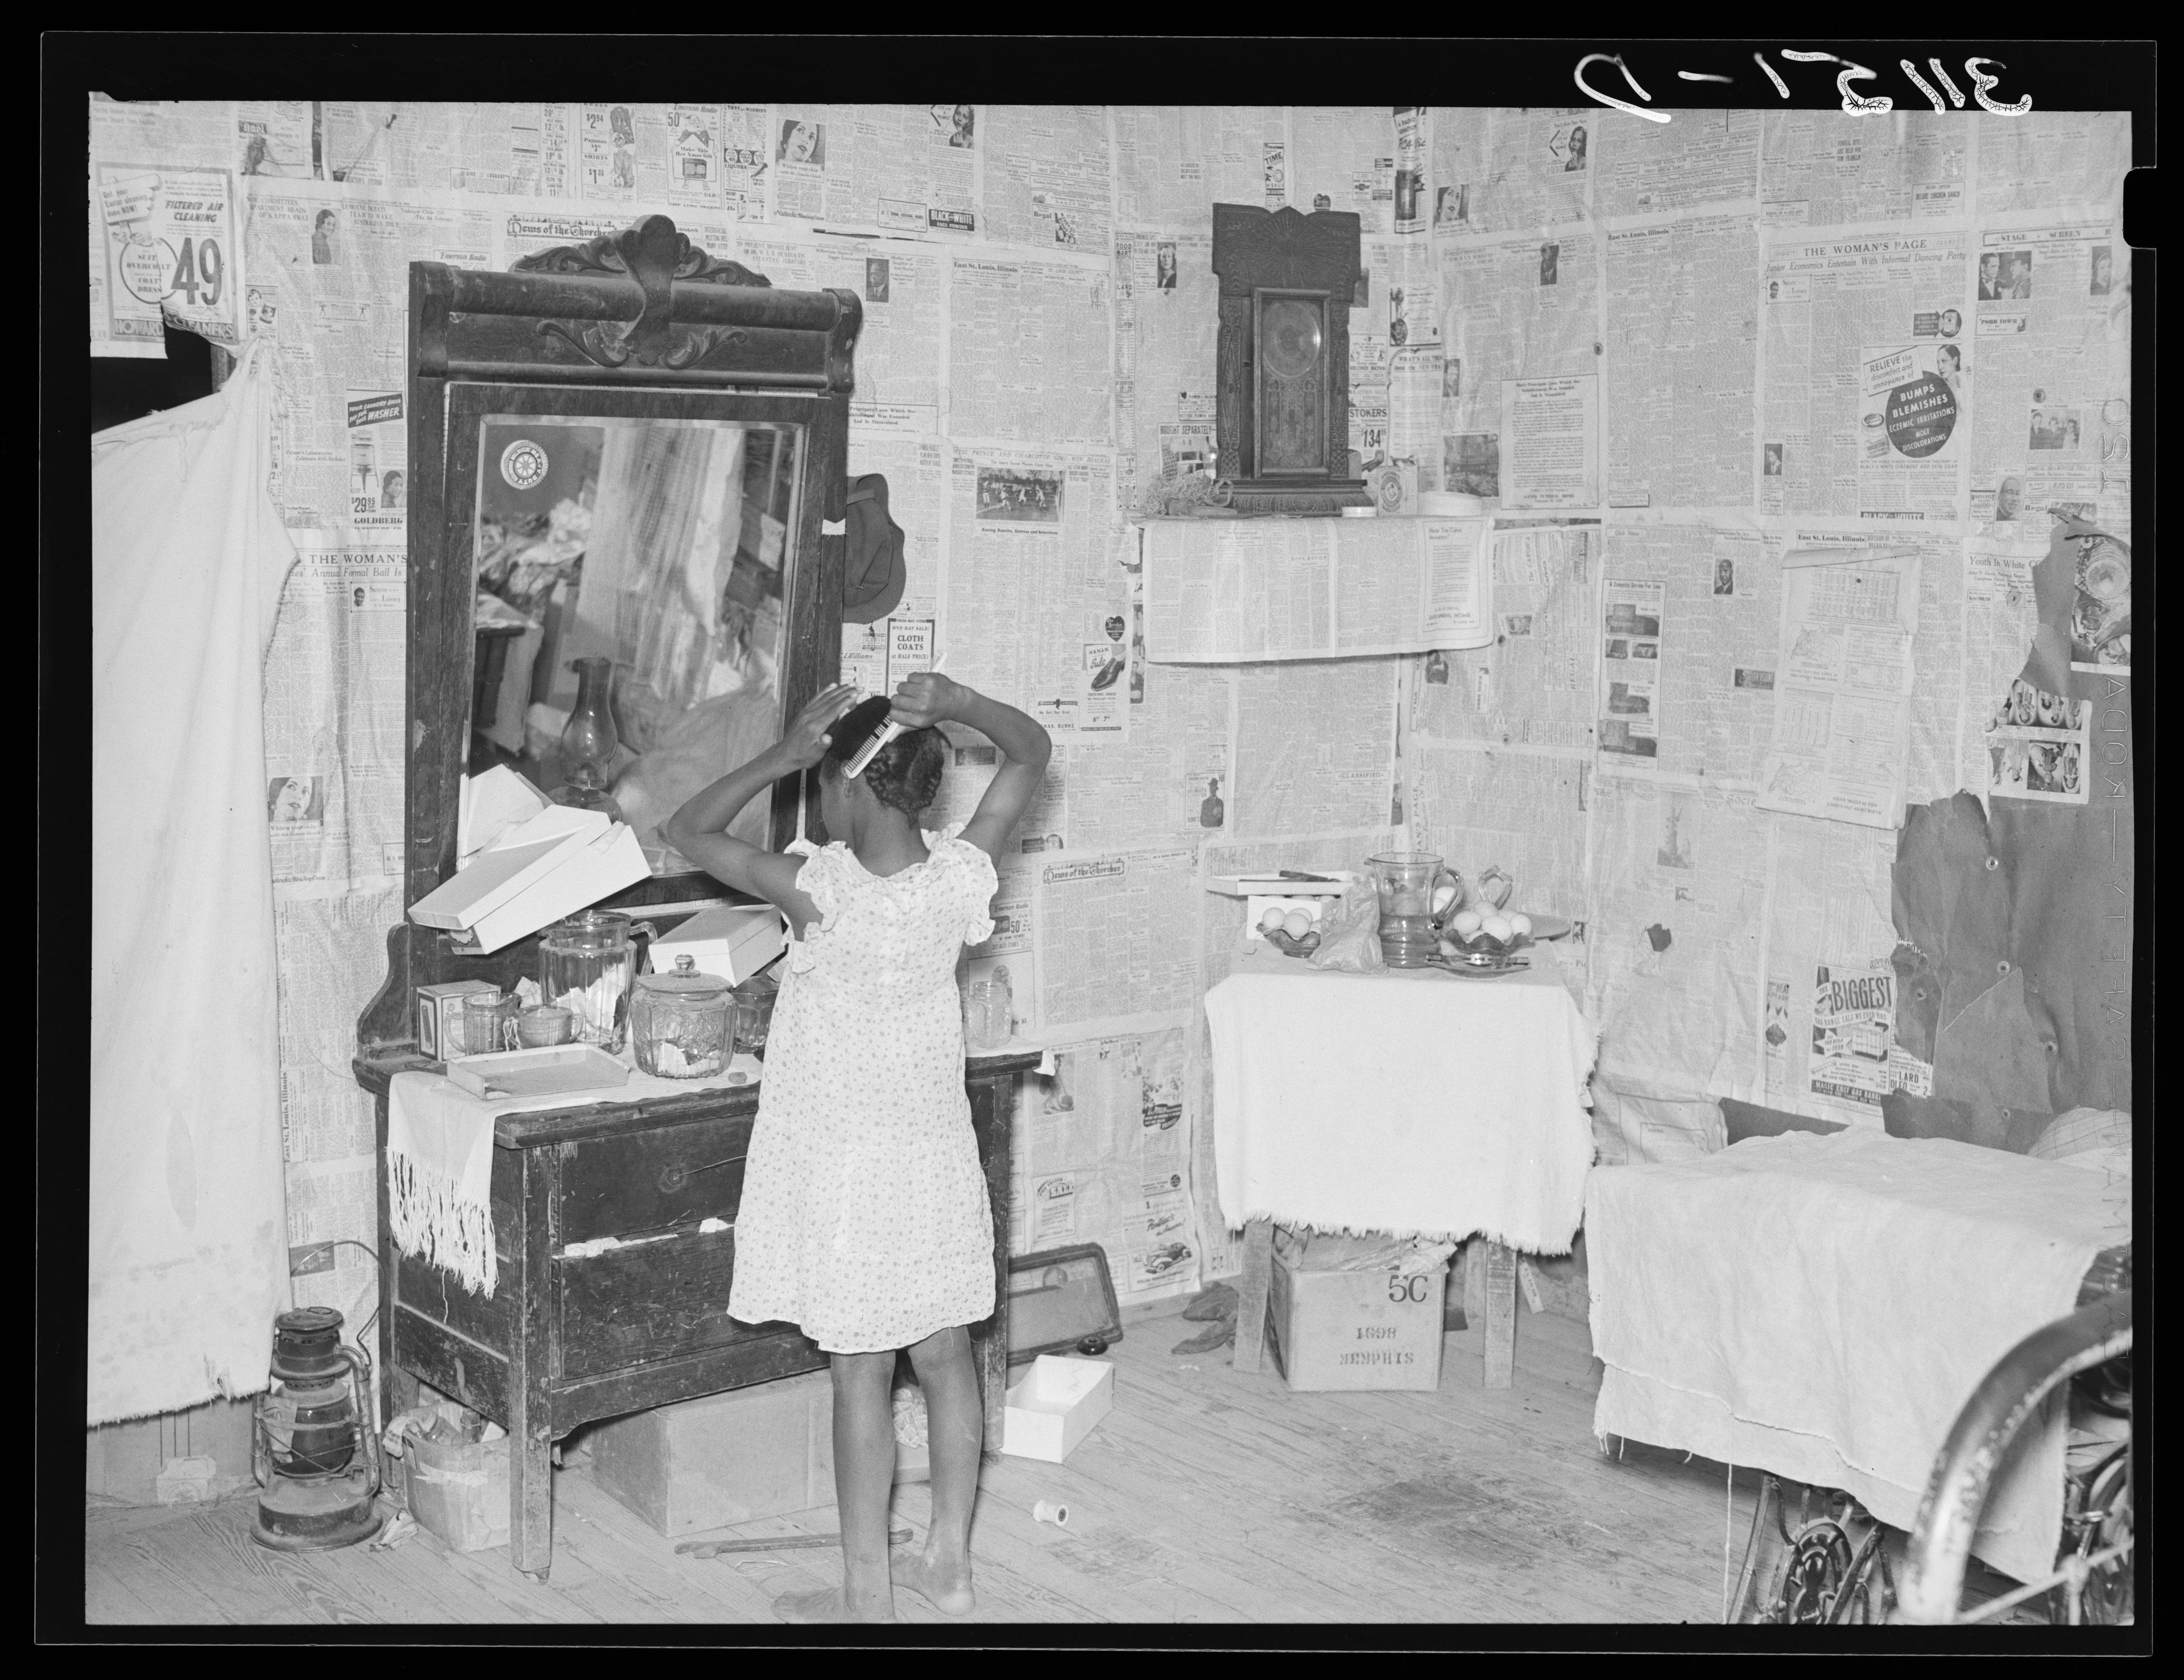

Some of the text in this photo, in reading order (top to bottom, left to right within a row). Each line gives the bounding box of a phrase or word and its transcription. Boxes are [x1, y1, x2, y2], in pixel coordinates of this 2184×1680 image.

[1264, 152, 1284, 165] TIME
[105, 199, 122, 208] Easter
[121, 205, 137, 214] NOW!
[165, 200, 224, 212] FILTERED AIR
[174, 212, 217, 223] CLEANING
[930, 210, 949, 221] BLACK
[954, 213, 973, 225] WHITE
[1804, 239, 1927, 257] THE WOMAN'S PAGE
[1766, 251, 1967, 272] Junior Economics Entertain With Informal Dancing Party
[1869, 354, 1912, 373] RELIEVE the
[1871, 361, 1913, 382] discomfort and
[1872, 369, 1914, 390] annoyance of
[1900, 383, 1935, 402] BUMPS
[1349, 408, 1387, 418] STOKERS
[1892, 394, 1949, 419] BLEMISHES
[367, 407, 400, 421] WASHER
[1889, 406, 1955, 433] ECZEMIC IRRITATIONS
[1160, 425, 1179, 435] BOUGHT
[1915, 428, 1930, 438] MOLE
[1902, 433, 1947, 452] DISCOLORATIONS
[1015, 452, 1052, 461] CHARLOTTE
[309, 555, 338, 564] THE
[1970, 556, 1991, 568] Youth
[1993, 558, 2001, 568] In
[2003, 559, 2026, 569] White
[311, 568, 341, 577] Annual
[343, 568, 369, 577] Formal
[373, 567, 390, 577] Ball
[1090, 656, 1106, 669] Sale
[1819, 986, 1829, 994] THE
[1831, 976, 1892, 1011] BIGGEST
[1899, 1071, 1919, 1083] LARD
[1815, 1081, 1834, 1091] MAGIC
[1388, 1275, 1428, 1302] 5C
[1339, 1352, 1414, 1365] MEMPHIS
